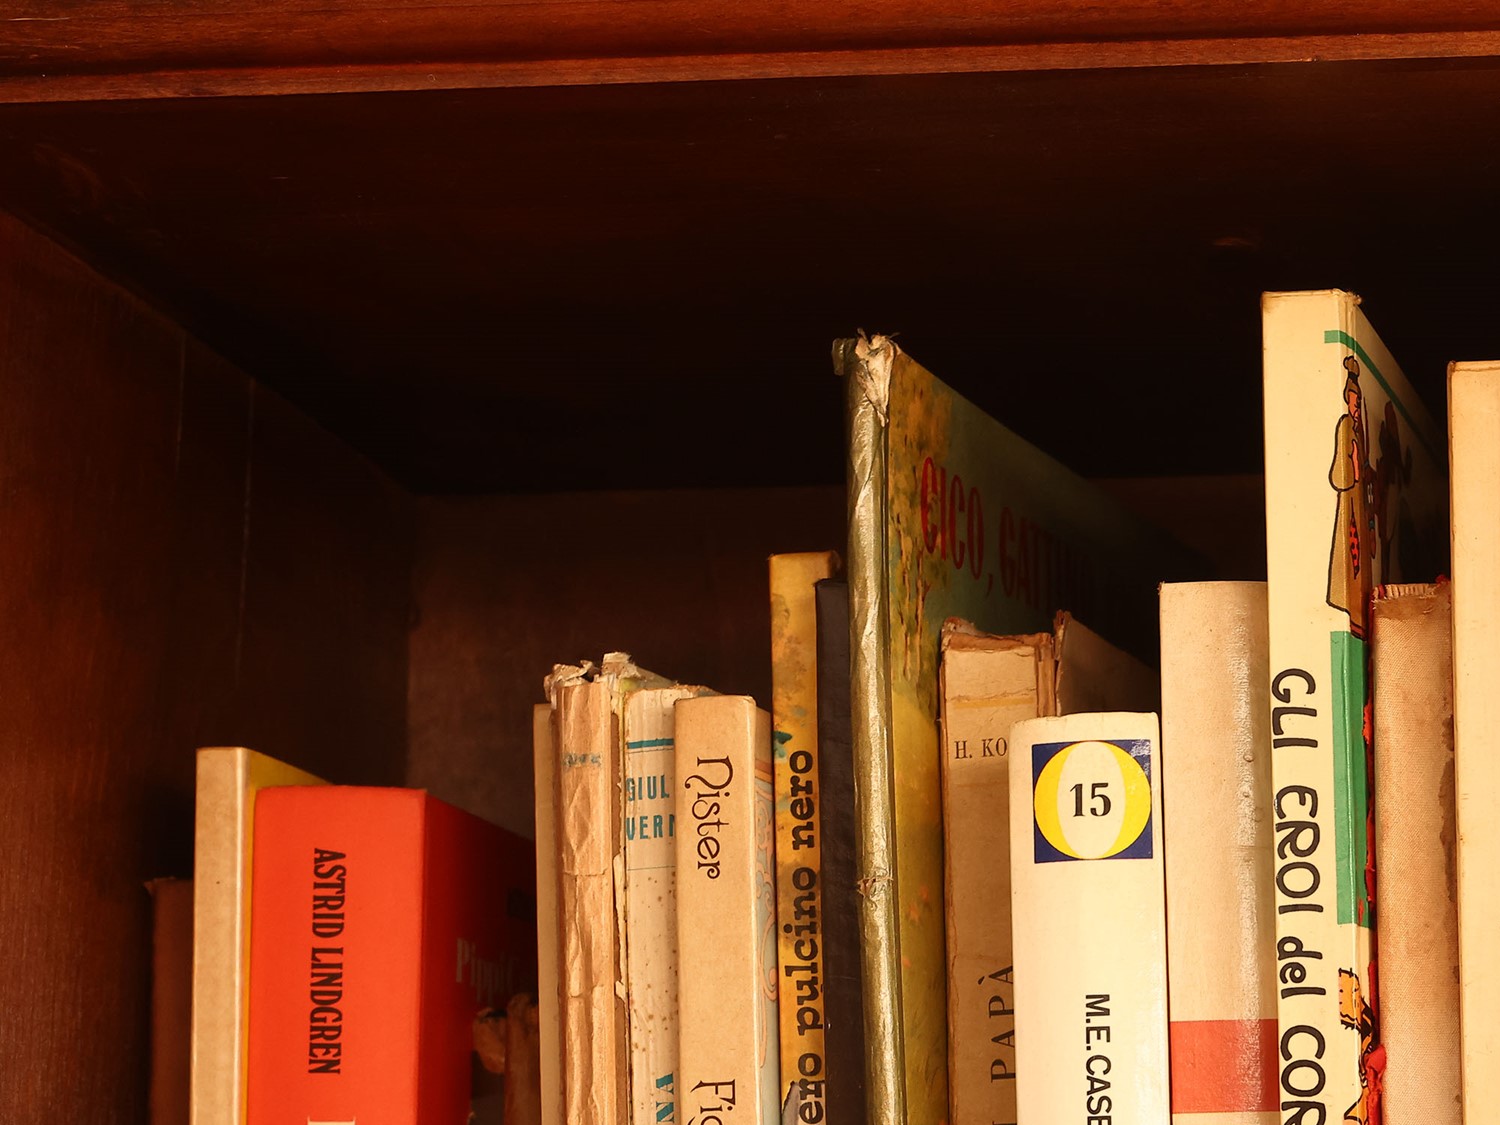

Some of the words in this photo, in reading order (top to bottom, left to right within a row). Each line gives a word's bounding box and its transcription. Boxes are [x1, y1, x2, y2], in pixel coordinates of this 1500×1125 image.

[954, 739, 973, 760] H.
[981, 736, 1008, 758] KO
[1272, 667, 1318, 749] GLI
[684, 755, 734, 880] Nister
[789, 750, 816, 851] nero
[1070, 783, 1112, 818] 15
[313, 848, 346, 939] ASTRID
[1274, 784, 1324, 914] EROI
[784, 867, 822, 1036] pulcino
[1276, 935, 1327, 1000] del
[308, 947, 345, 1075] LINDGREN
